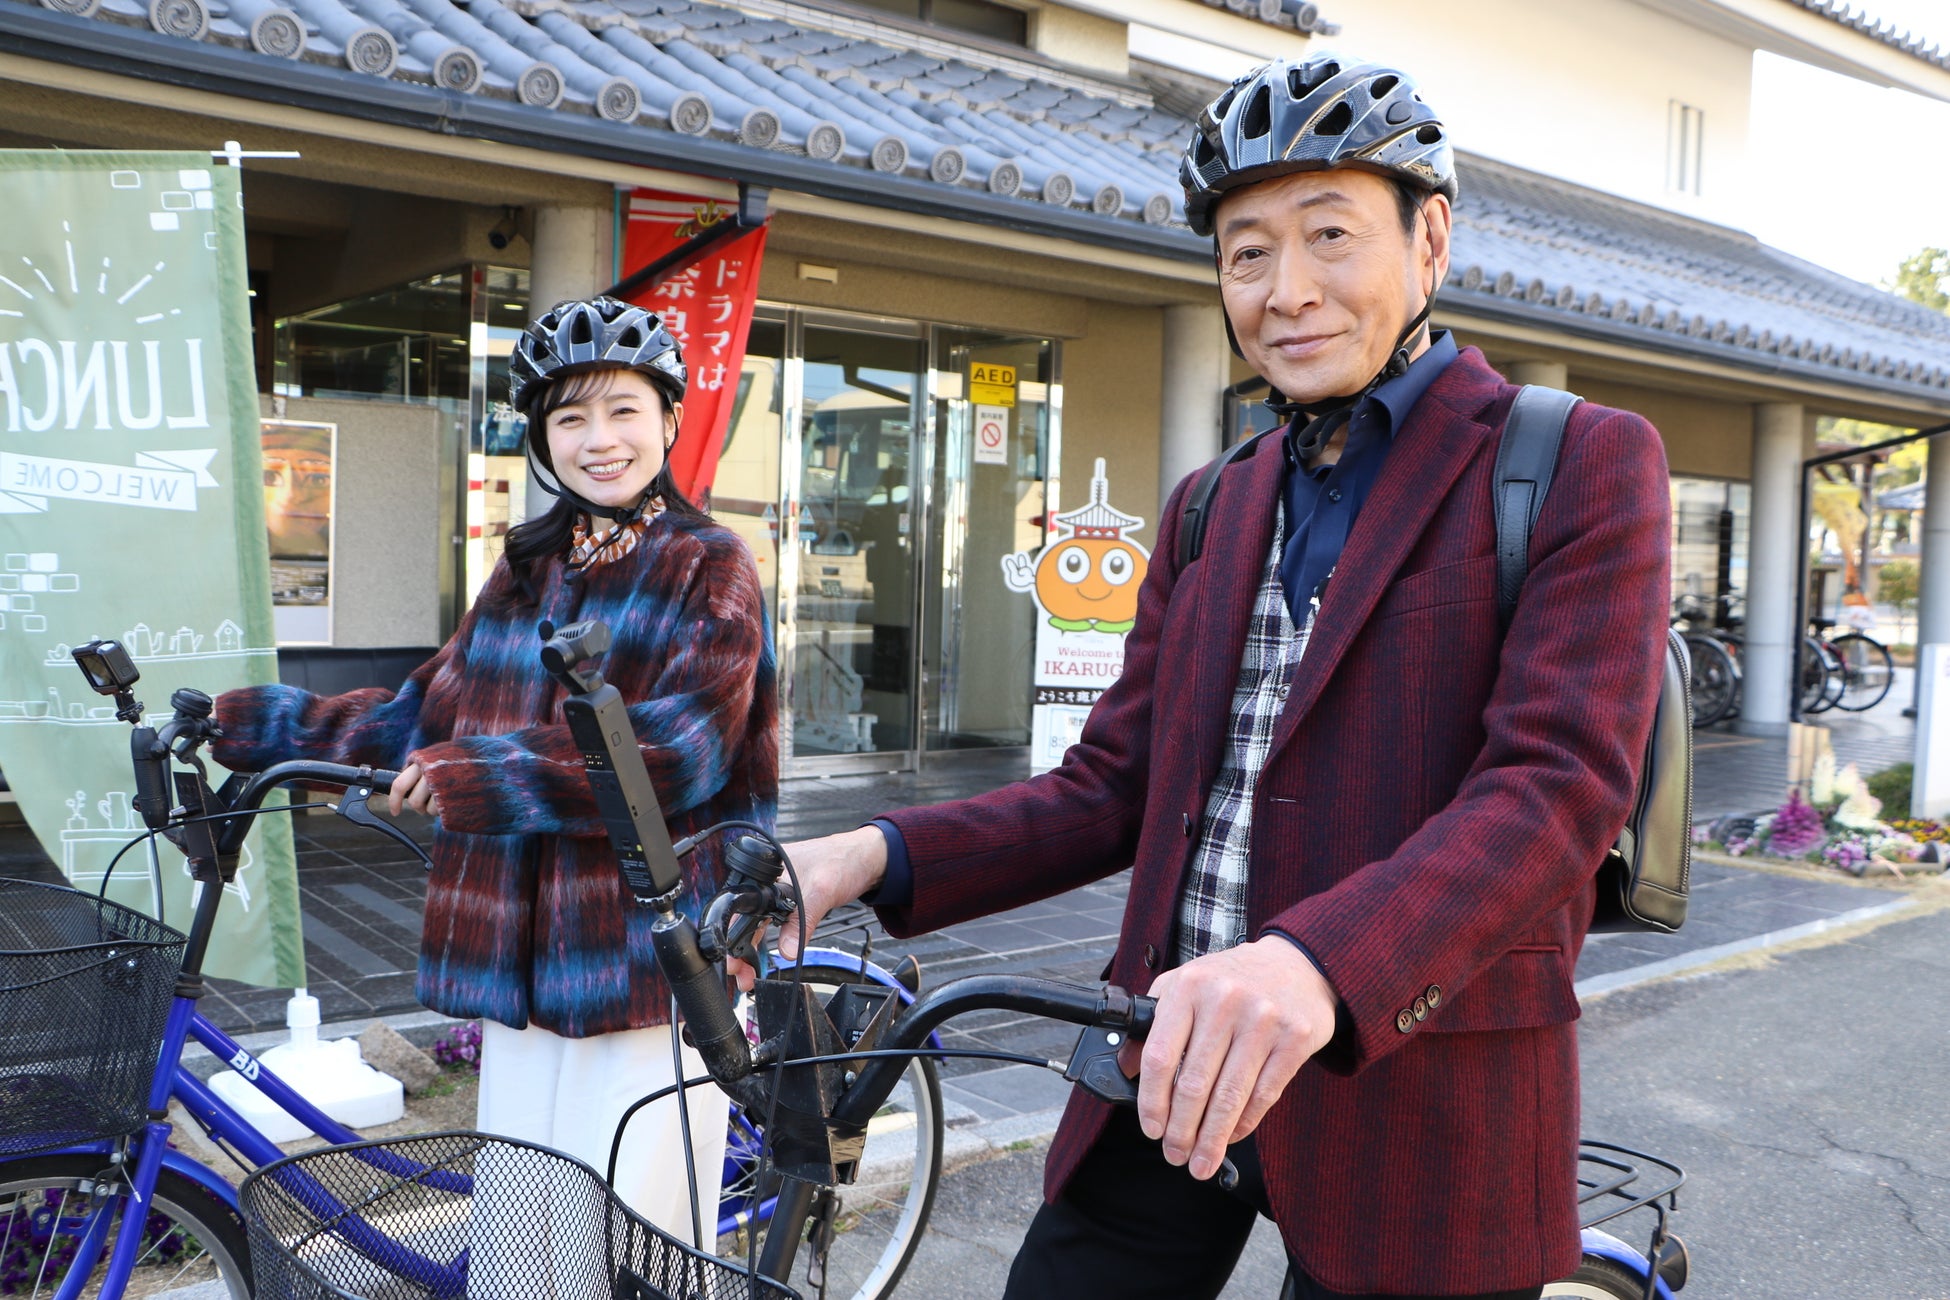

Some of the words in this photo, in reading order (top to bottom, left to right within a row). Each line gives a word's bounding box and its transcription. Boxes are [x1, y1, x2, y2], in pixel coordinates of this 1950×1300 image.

[697, 259, 742, 391] ドラマは
[973, 368, 1013, 384] AED
[1058, 646, 1113, 658] Welcome
